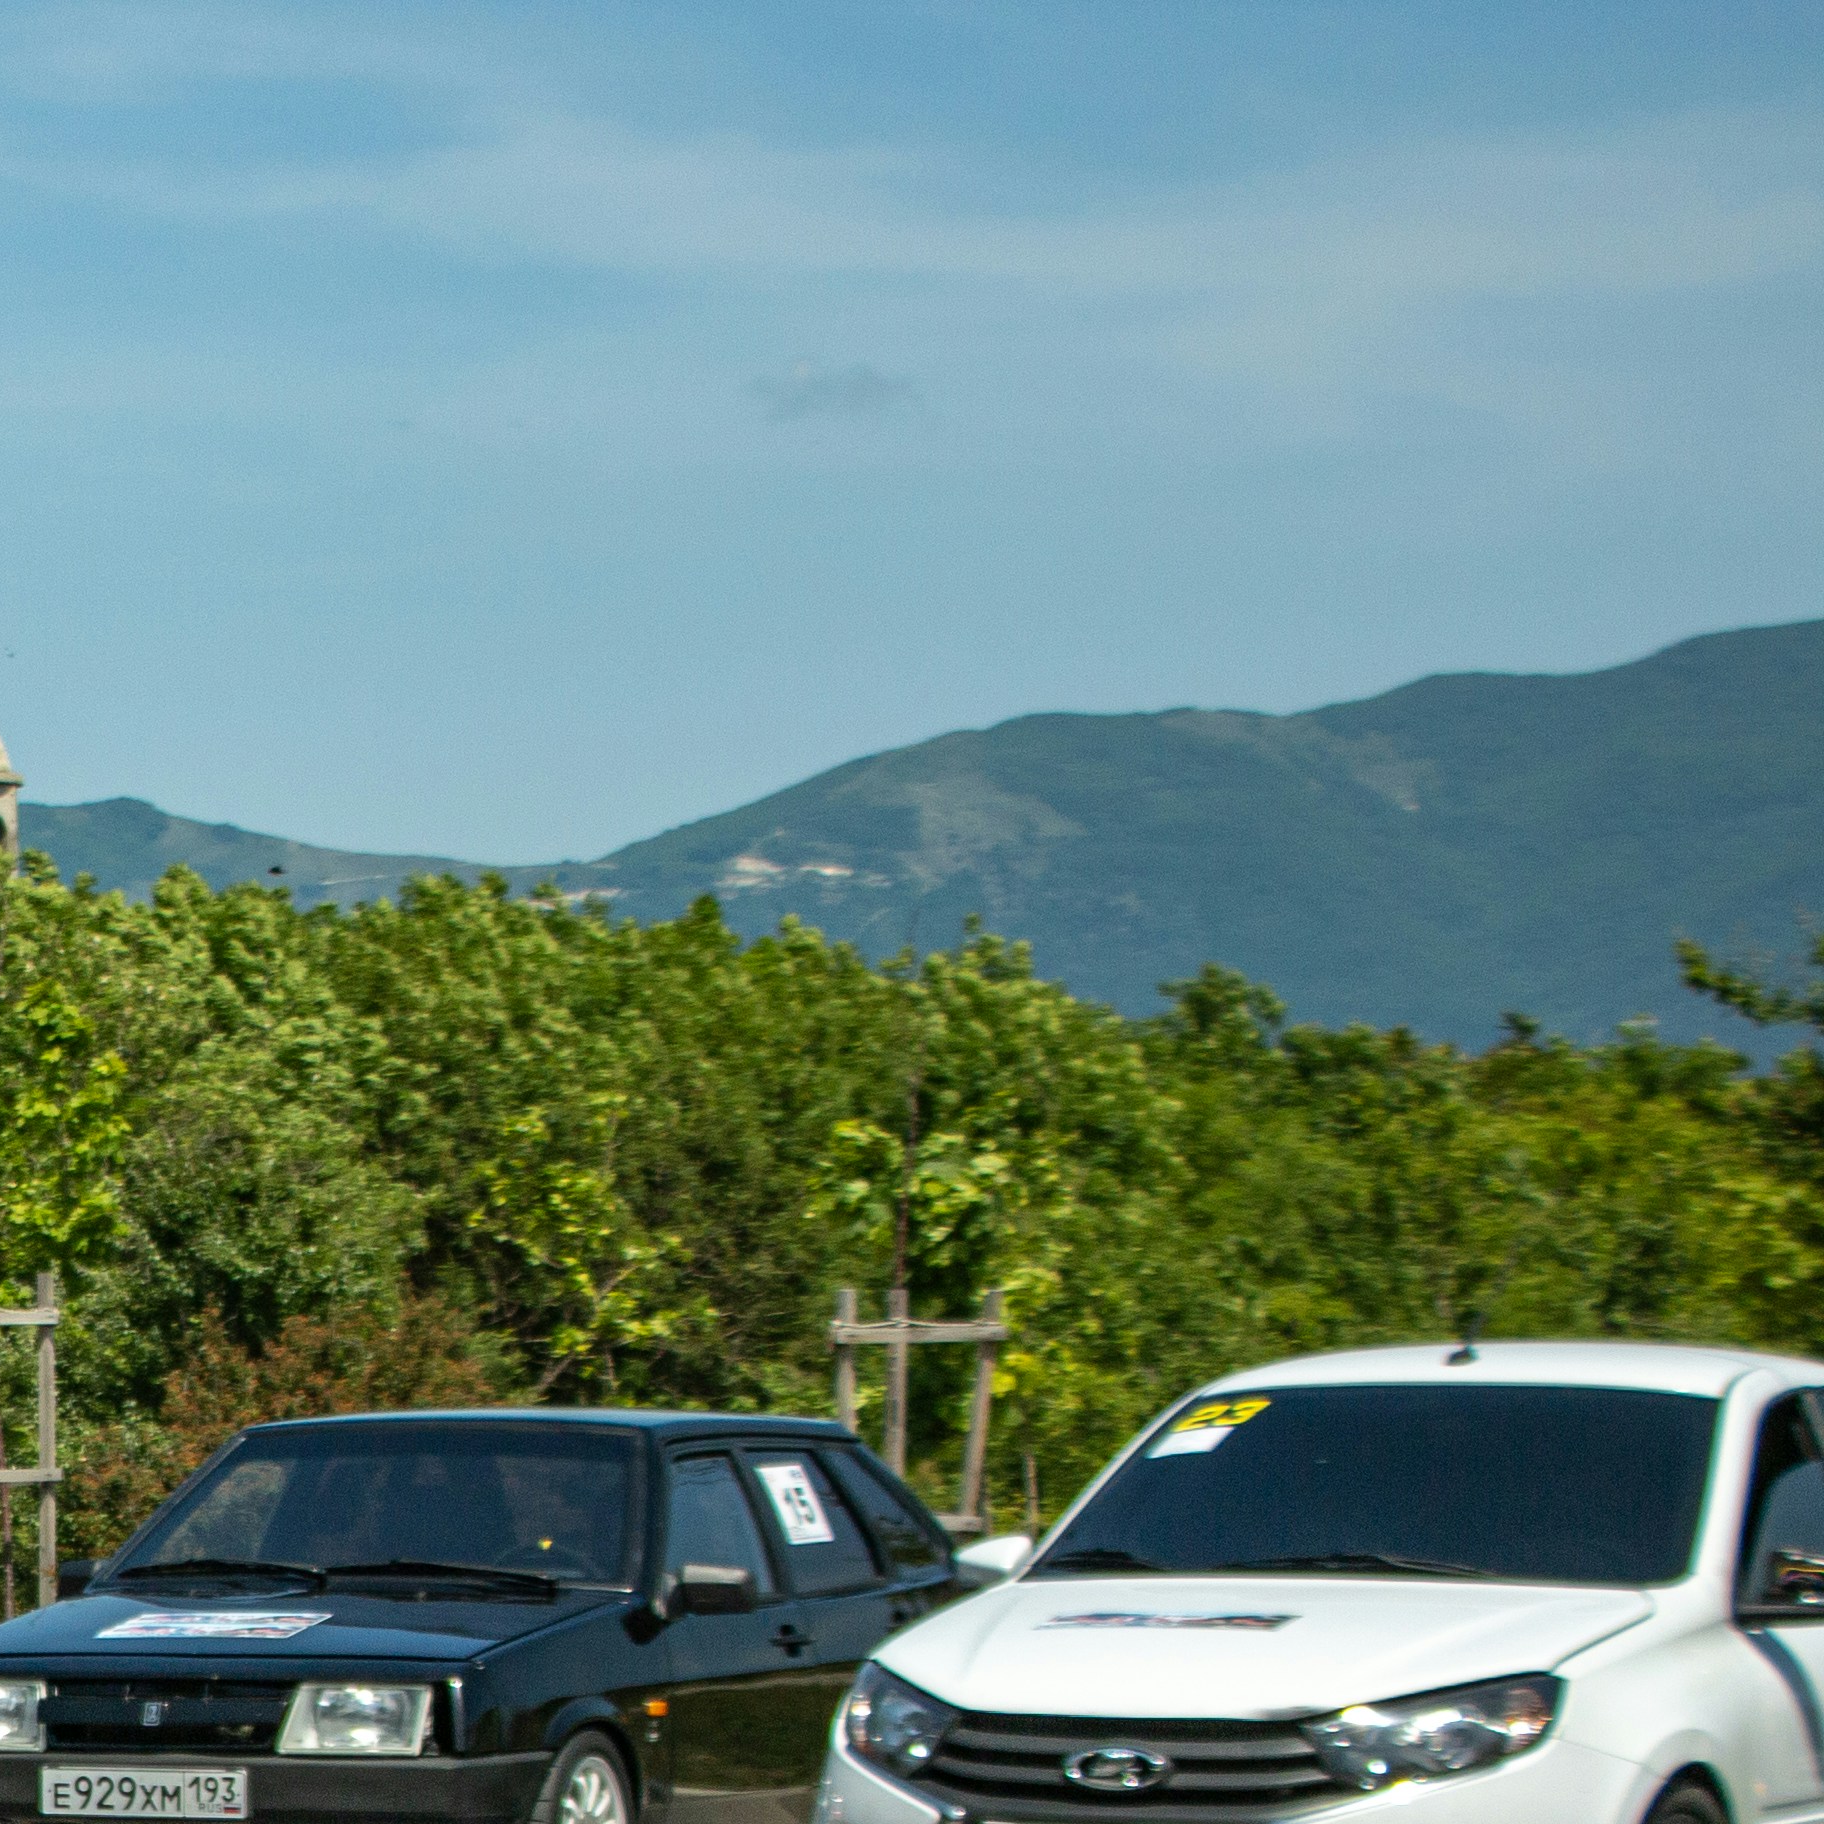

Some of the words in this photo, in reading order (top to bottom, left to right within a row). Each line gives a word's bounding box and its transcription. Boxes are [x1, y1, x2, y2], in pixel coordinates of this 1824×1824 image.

[1173, 1399, 1271, 1432] 23
[783, 1486, 816, 1526] 15
[189, 1776, 237, 1803] 193
